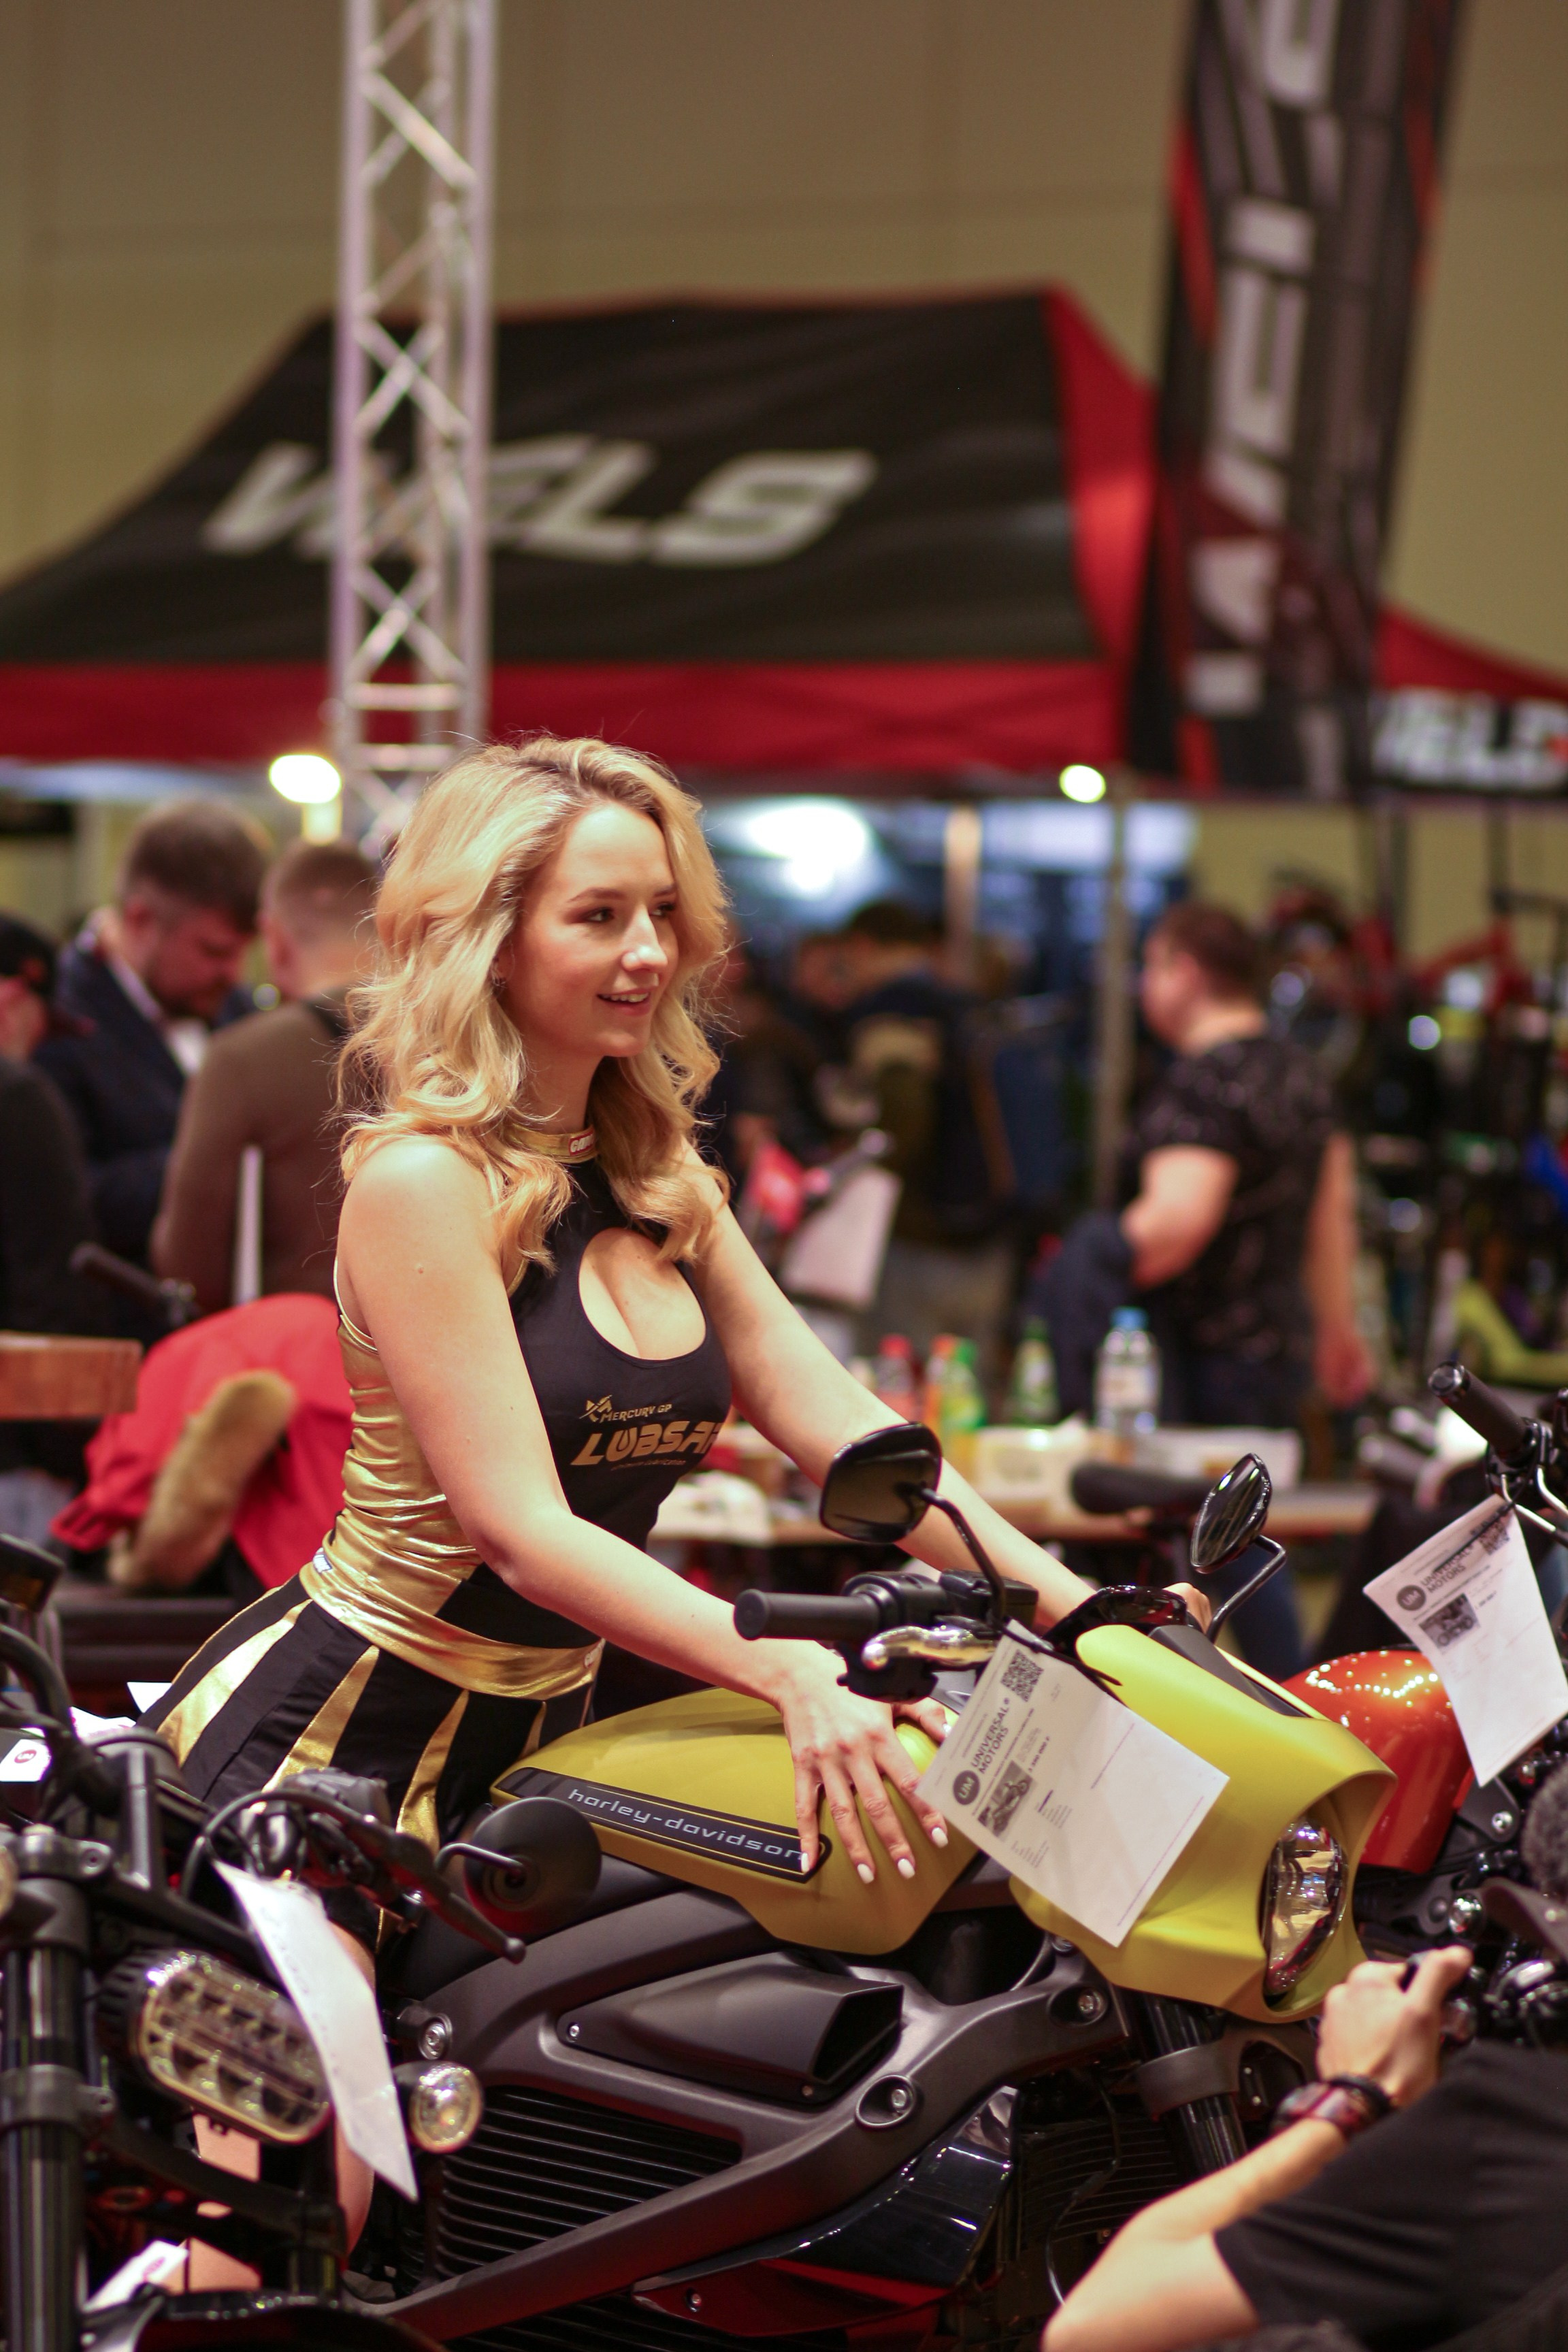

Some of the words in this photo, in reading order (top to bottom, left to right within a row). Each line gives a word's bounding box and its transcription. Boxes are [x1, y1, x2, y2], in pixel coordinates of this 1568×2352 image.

[599, 1406, 656, 1423] MERCURY
[657, 1404, 672, 1413] GP
[1427, 1564, 1466, 1593] MOTORS
[979, 1727, 1009, 1774] MOTORS
[958, 1776, 975, 1799] UM
[568, 1788, 802, 1860] harley-davidson
